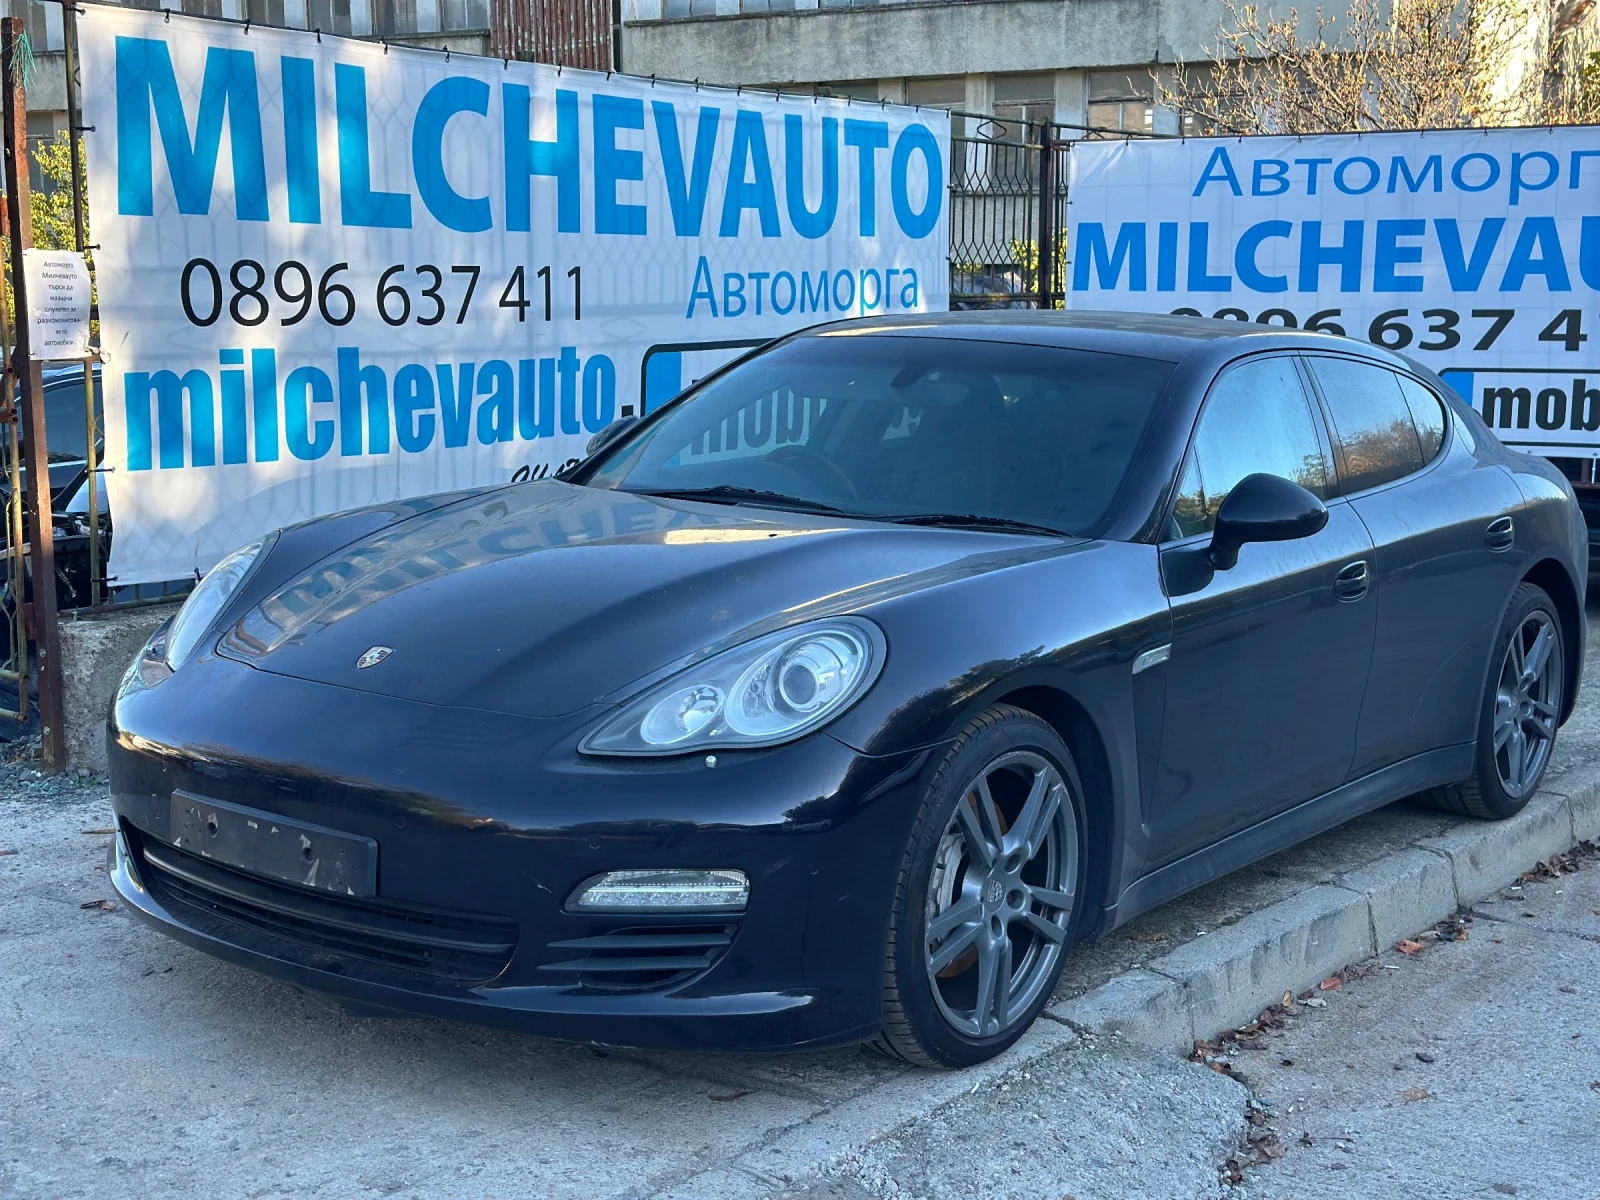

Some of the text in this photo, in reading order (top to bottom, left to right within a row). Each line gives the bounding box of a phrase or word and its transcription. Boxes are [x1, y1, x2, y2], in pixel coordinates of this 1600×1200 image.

[115, 36, 943, 239] MILCHEVAUTO
[181, 259, 582, 327] 0896 637 411
[686, 256, 918, 318] Автоморга
[1368, 309, 1515, 351] 637
